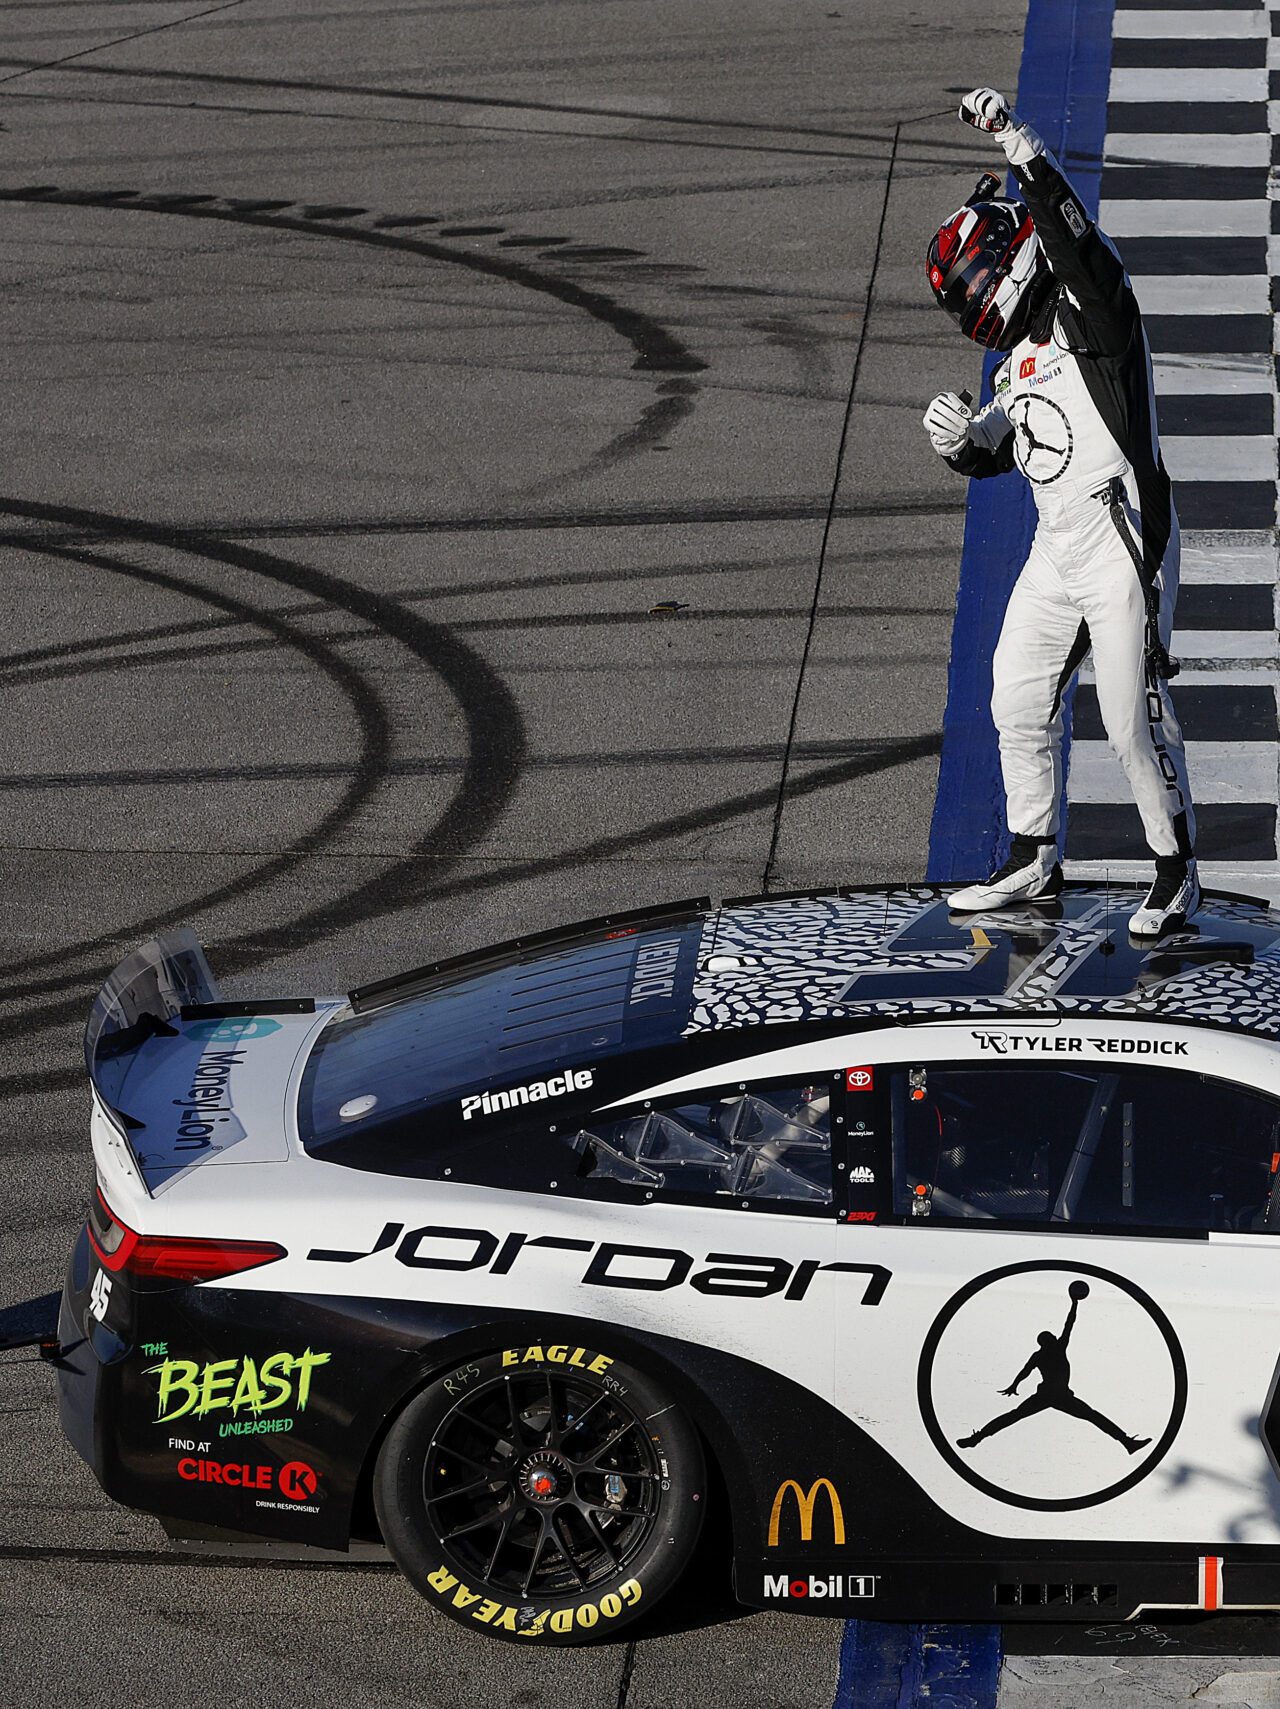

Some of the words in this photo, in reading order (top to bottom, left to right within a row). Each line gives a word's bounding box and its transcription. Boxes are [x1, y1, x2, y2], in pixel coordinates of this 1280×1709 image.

[1028, 372, 1053, 388] Mobil
[629, 937, 681, 1005] REDDICK
[1009, 1036, 1083, 1052] TYLER
[1086, 1038, 1189, 1056] REDDICK
[172, 1050, 248, 1151] MoneyLion
[461, 1069, 594, 1121] Pinnacle
[849, 1166, 875, 1179] MAC
[88, 1267, 112, 1322] 45
[140, 1342, 169, 1357] THE
[502, 1345, 615, 1376] EAGLE
[141, 1347, 332, 1424] BEAST
[219, 1418, 294, 1437] UNLEASHED
[168, 1438, 195, 1451] FIND
[197, 1442, 212, 1453] AT
[177, 1457, 273, 1490] CIRCLE
[283, 1464, 317, 1500] K
[255, 1501, 276, 1510] DRINK
[277, 1502, 320, 1514] RESPONSIBLY
[763, 1575, 843, 1598] Mobil
[426, 1565, 643, 1637] GOODYEAR
